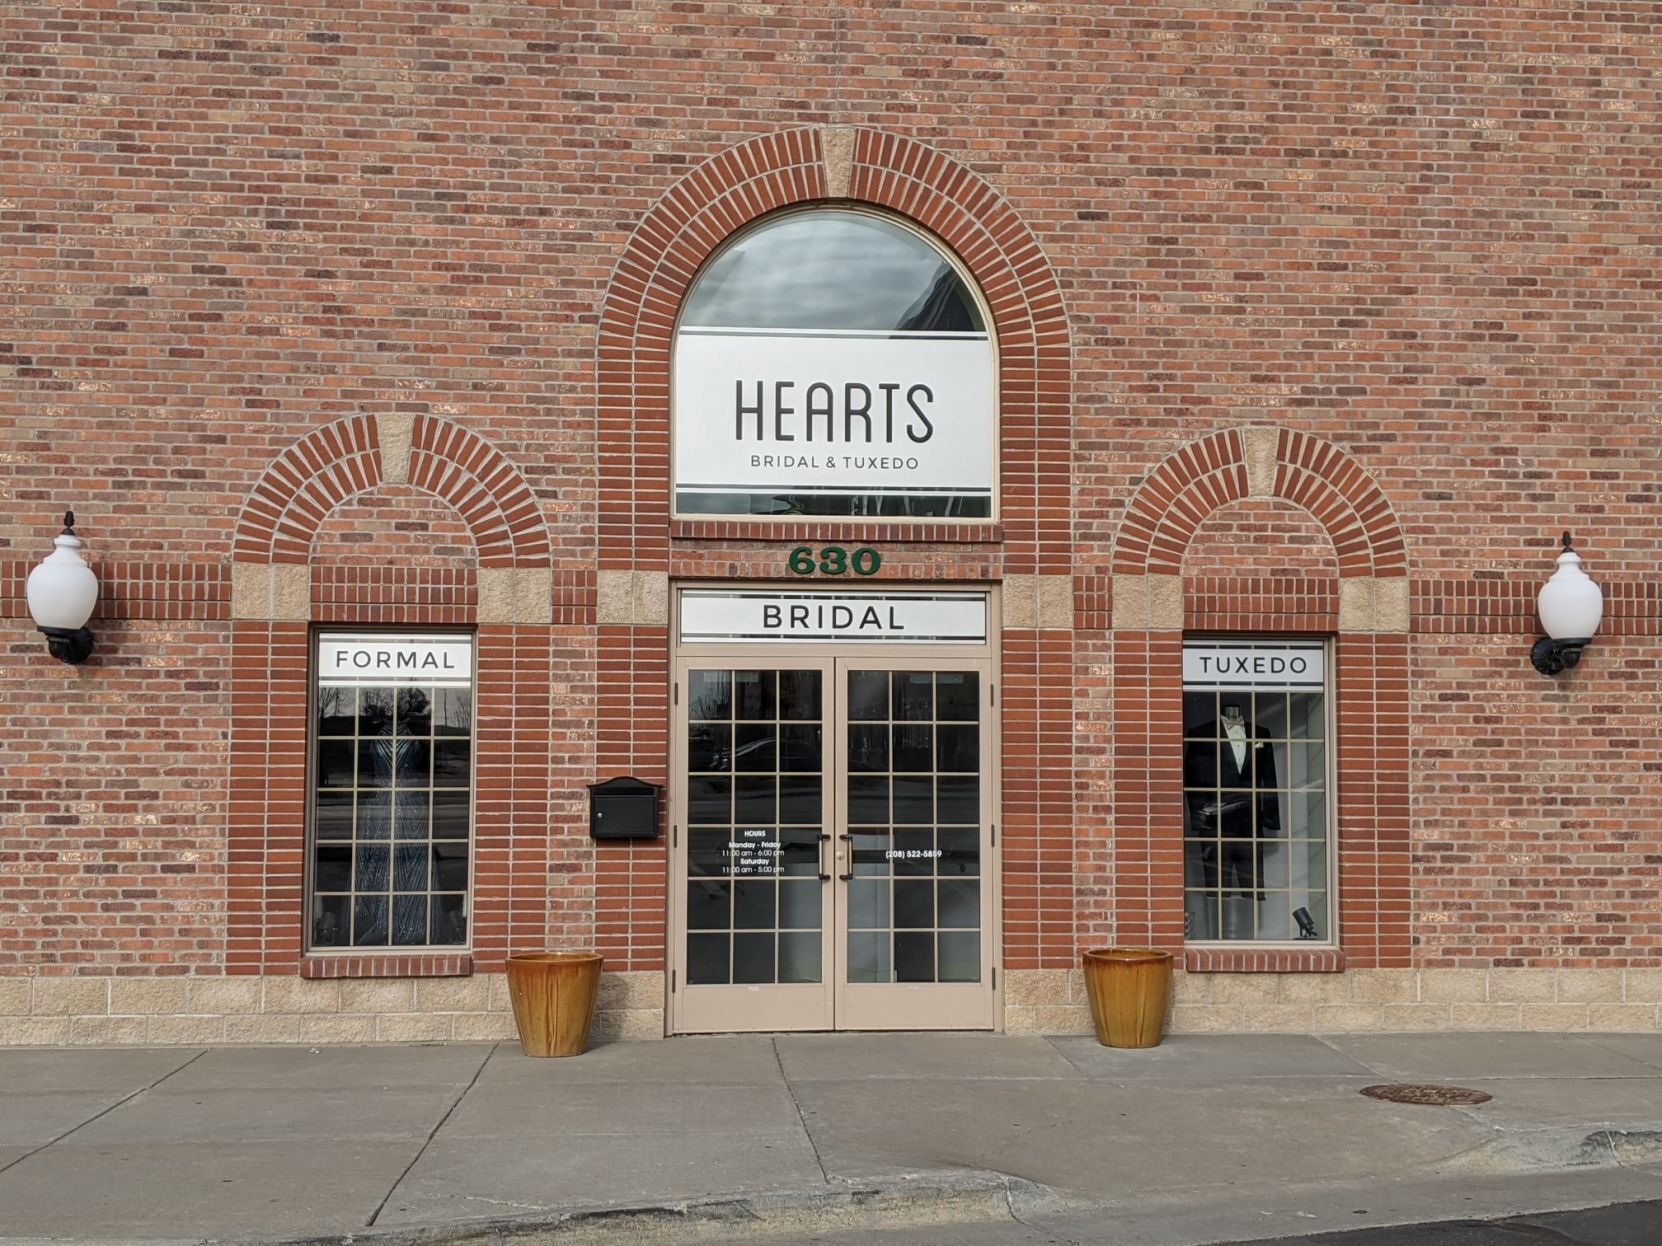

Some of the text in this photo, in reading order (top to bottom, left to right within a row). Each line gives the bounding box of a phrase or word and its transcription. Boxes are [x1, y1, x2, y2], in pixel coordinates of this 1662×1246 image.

[735, 379, 934, 443] HEARTS
[750, 455, 919, 470] BRIDAL & TUXEDO
[788, 546, 881, 575] 630
[762, 604, 904, 630] BRIDAL
[336, 650, 455, 669] FORMAL
[1199, 656, 1307, 674] TUXEDO
[722, 849, 740, 857] 11:00
[757, 849, 772, 857] 6:00
[728, 841, 756, 849] Monday
[761, 841, 781, 849] Friday
[885, 850, 942, 859] (208) 522-5859
[722, 866, 740, 874] 11:00
